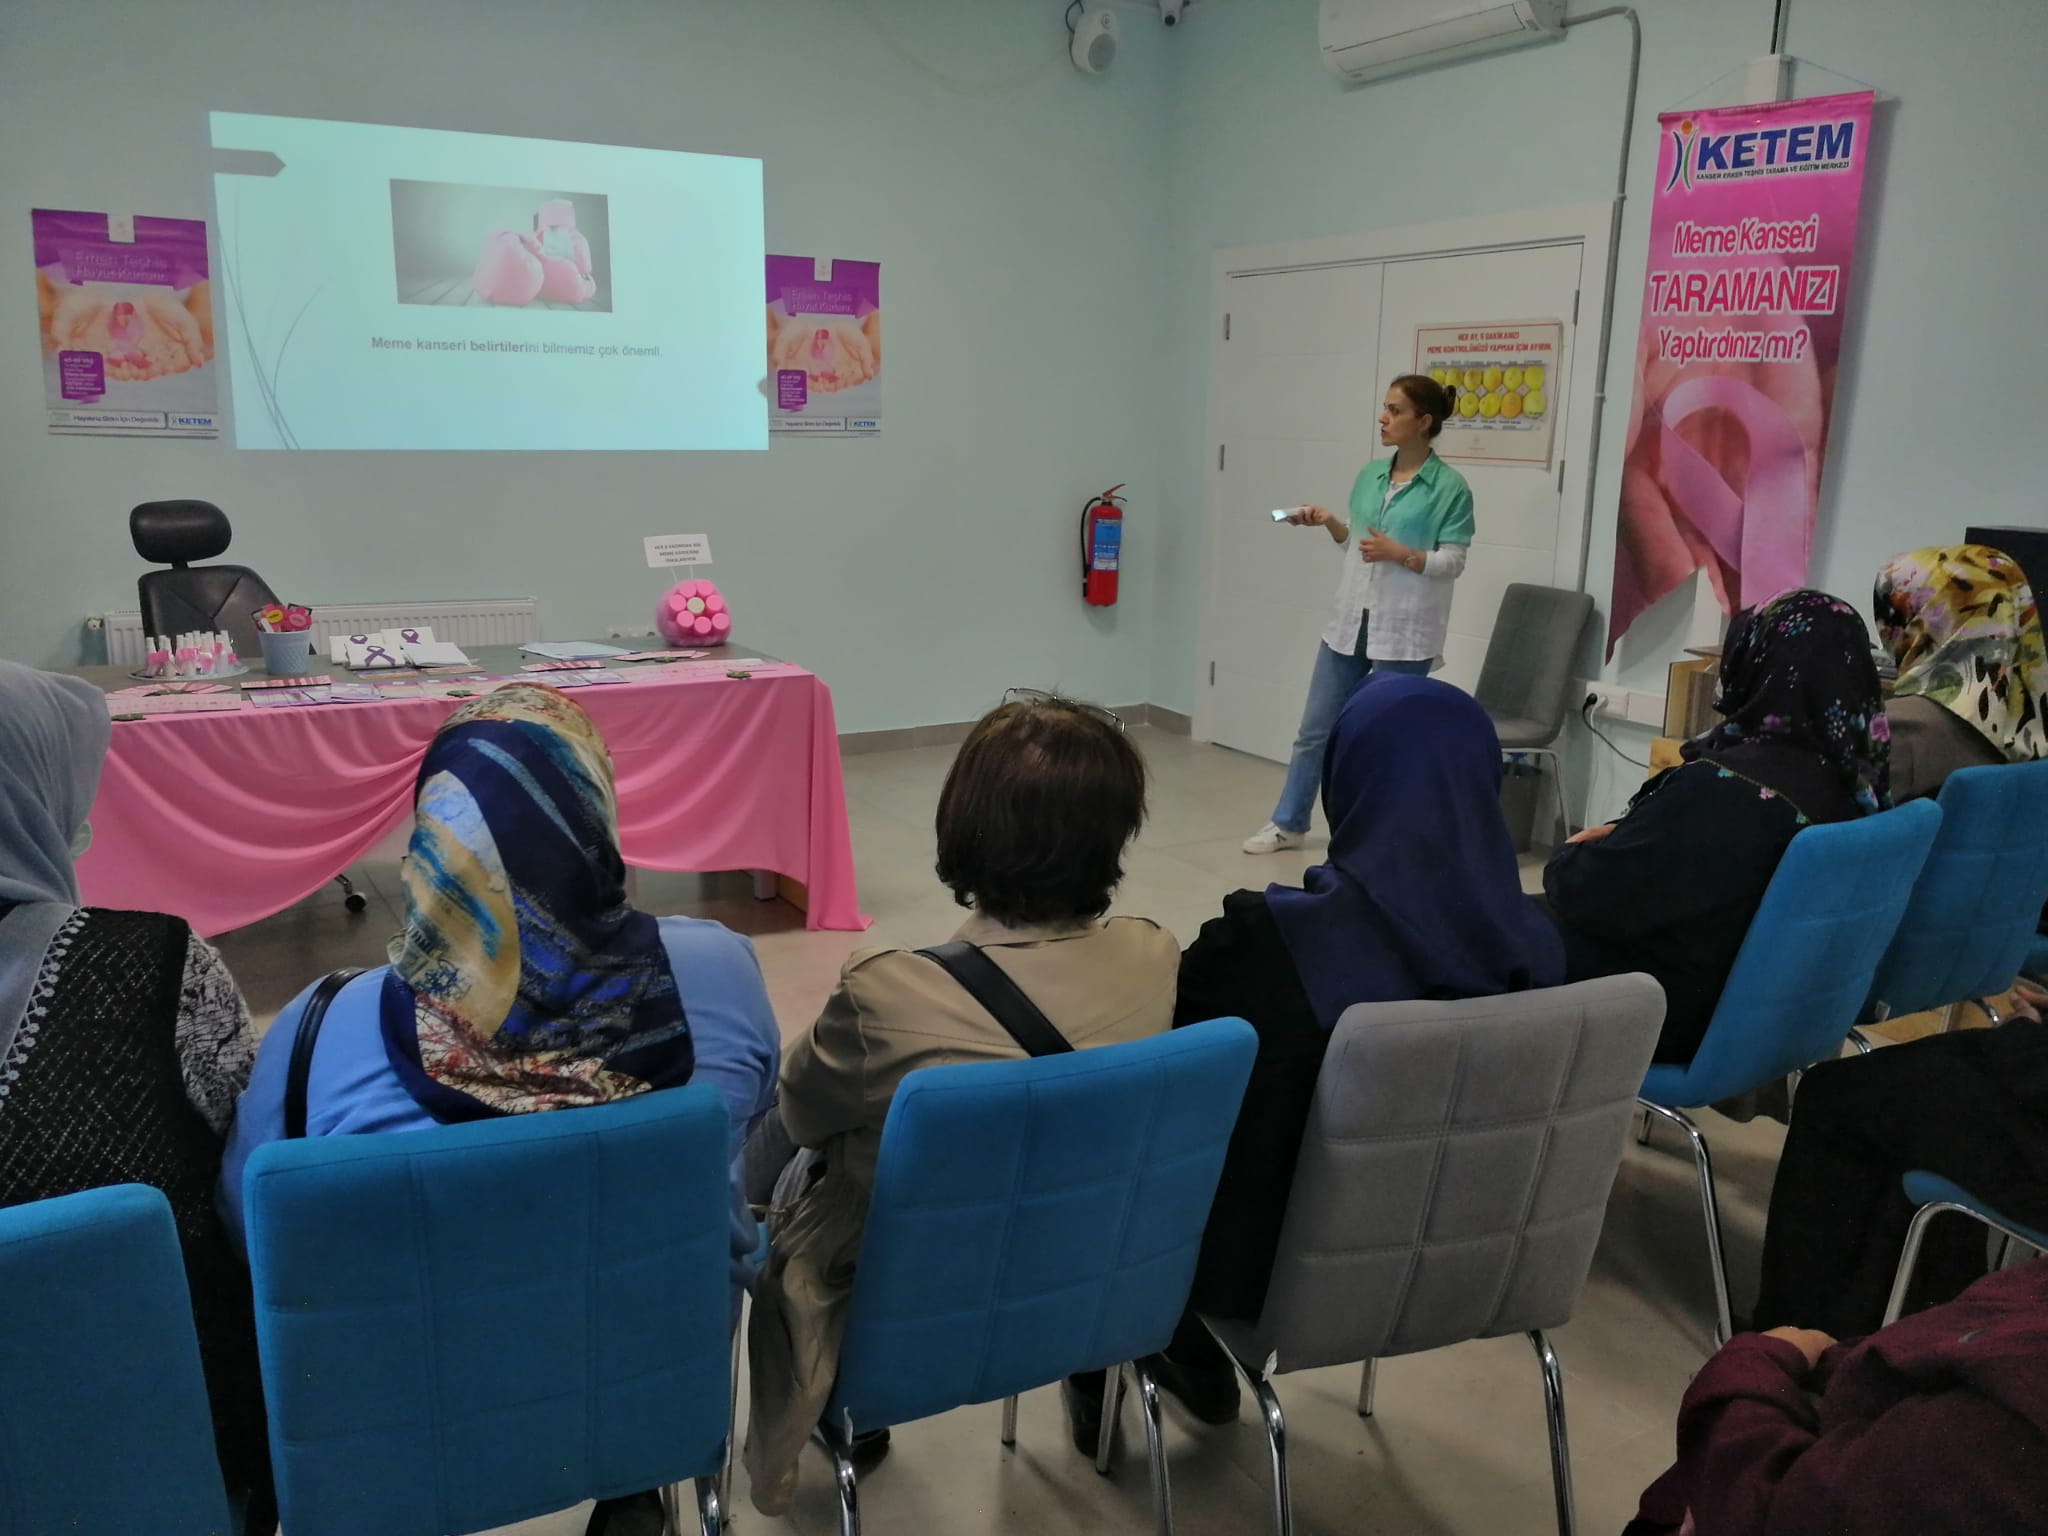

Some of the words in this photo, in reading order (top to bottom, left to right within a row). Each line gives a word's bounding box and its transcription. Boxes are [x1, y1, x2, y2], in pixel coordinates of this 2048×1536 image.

[1697, 121, 1855, 171] KETEM
[1695, 171, 1722, 180] KANSER
[1722, 170, 1743, 179] ERKEN
[1766, 166, 1789, 175] TARAMA
[1789, 165, 1798, 173] VE
[1673, 223, 1737, 254] Meme
[1740, 217, 1818, 251] Kanseri
[1651, 268, 1838, 313] TARAMANIZI
[371, 336, 412, 350] Meme
[416, 338, 467, 351] kanseri
[470, 340, 540, 353] belirtilerini
[542, 342, 595, 356] bilmemiz
[598, 345, 618, 358] çok
[622, 345, 663, 357] önemli.
[1659, 329, 1763, 365] Yaptırdınız
[1764, 329, 1808, 360] mı?
